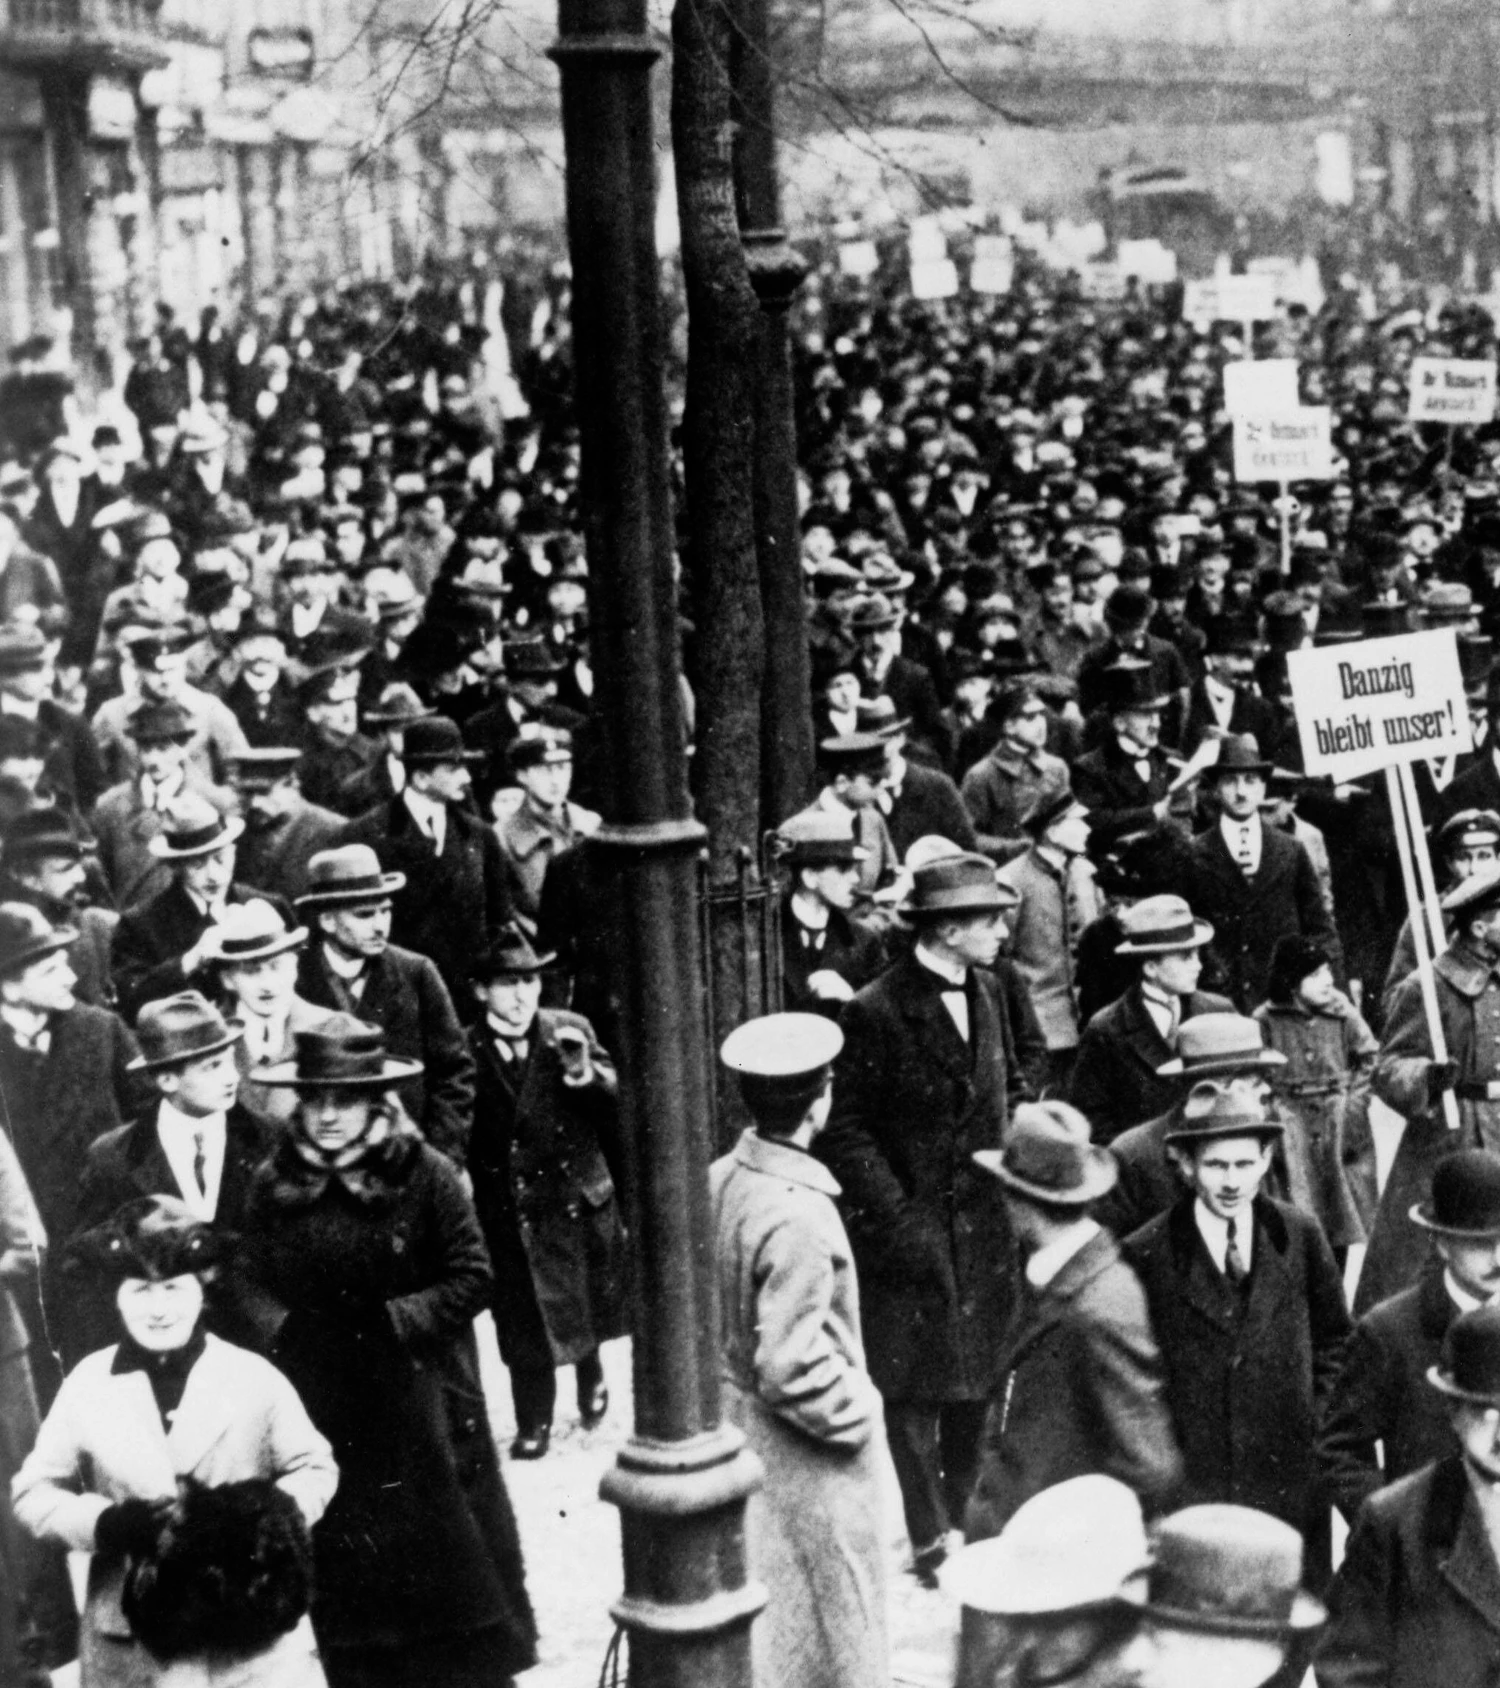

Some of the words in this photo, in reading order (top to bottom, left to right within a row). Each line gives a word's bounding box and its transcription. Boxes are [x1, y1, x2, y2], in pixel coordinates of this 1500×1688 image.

[1338, 657, 1414, 699] Danzig
[1314, 714, 1374, 755] bleibt
[1383, 699, 1456, 745] unser!
